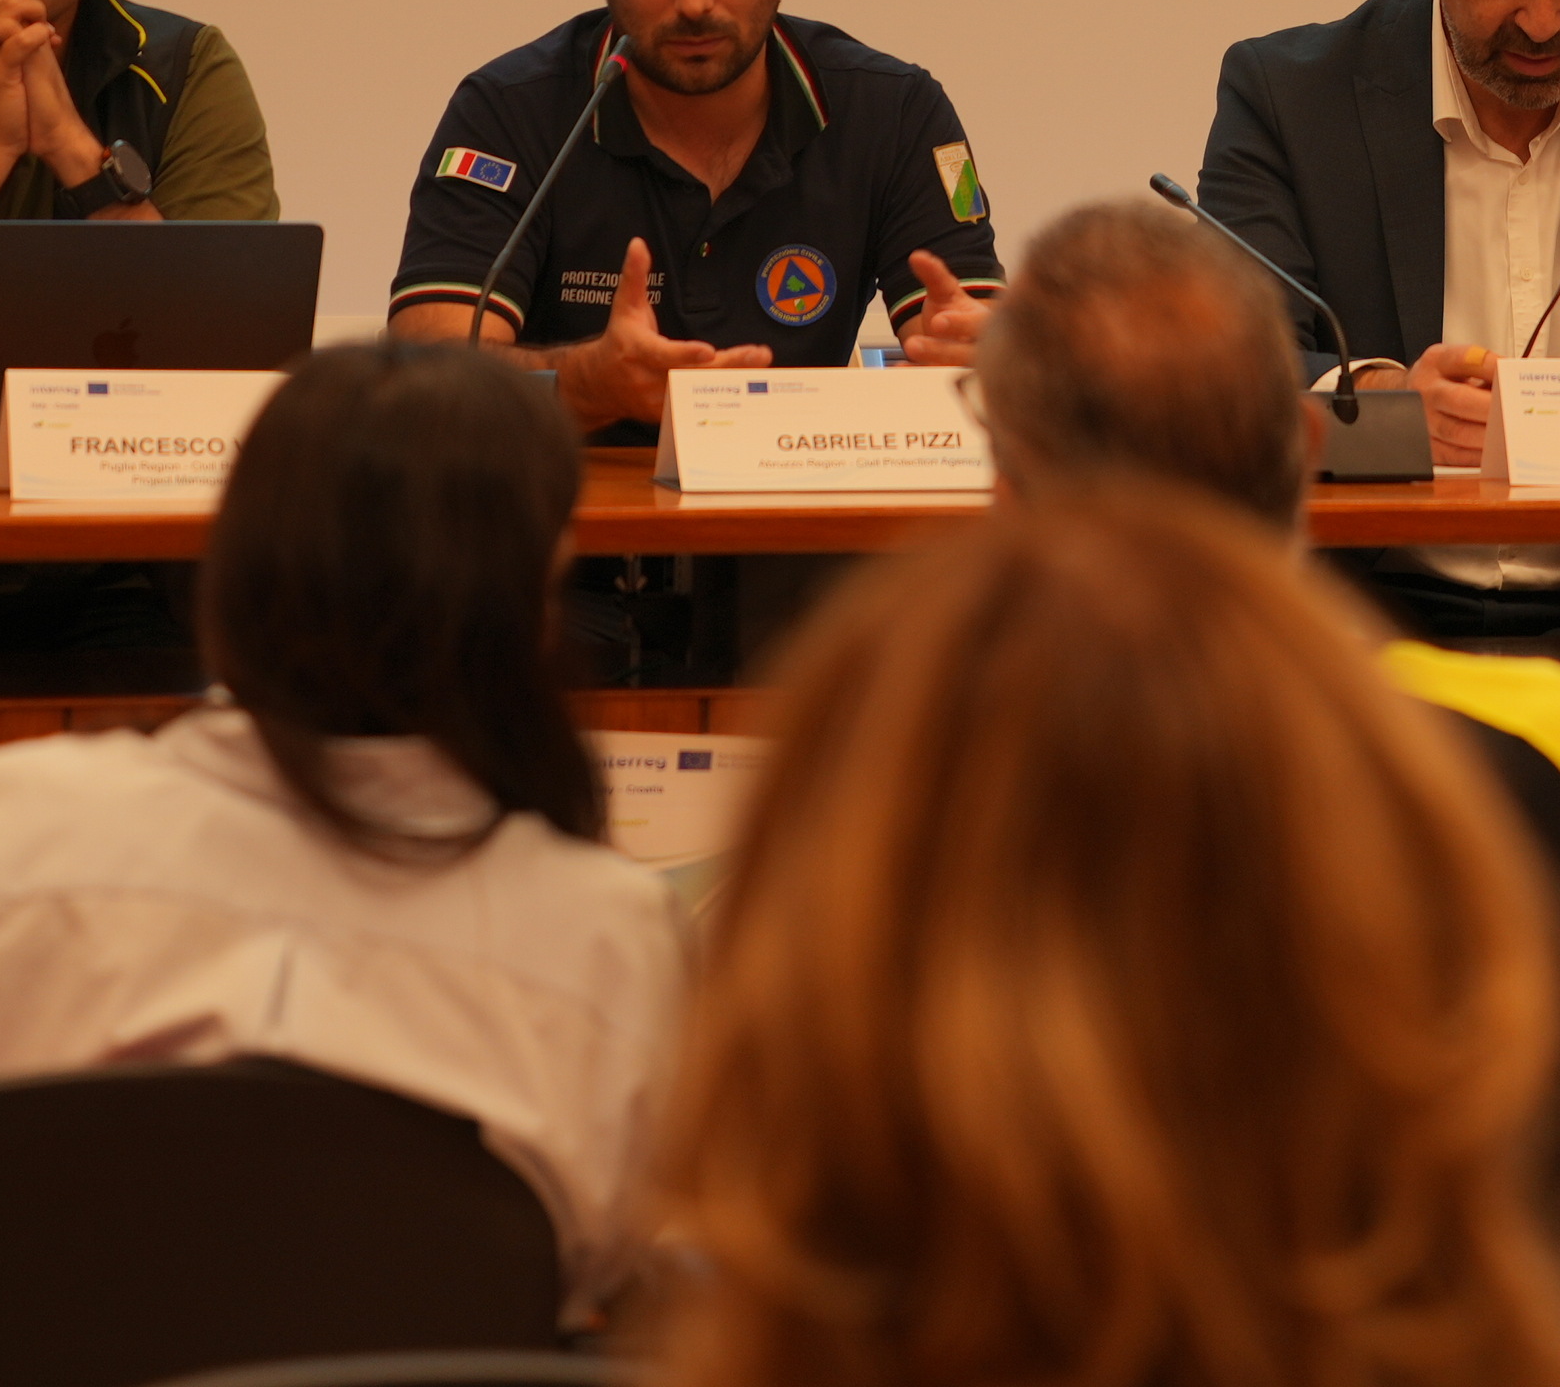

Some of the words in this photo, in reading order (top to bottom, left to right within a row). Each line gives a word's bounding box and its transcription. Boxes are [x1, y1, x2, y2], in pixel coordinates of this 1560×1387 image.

[561, 271, 623, 288] PROTEZIO
[560, 288, 613, 305] REGIONE
[70, 437, 226, 456] FRANCESCO
[777, 432, 898, 452] GABRIELE
[905, 432, 962, 449] PIZZI
[140, 461, 181, 474] Region
[882, 457, 938, 468] Protection
[940, 457, 982, 470] Agency
